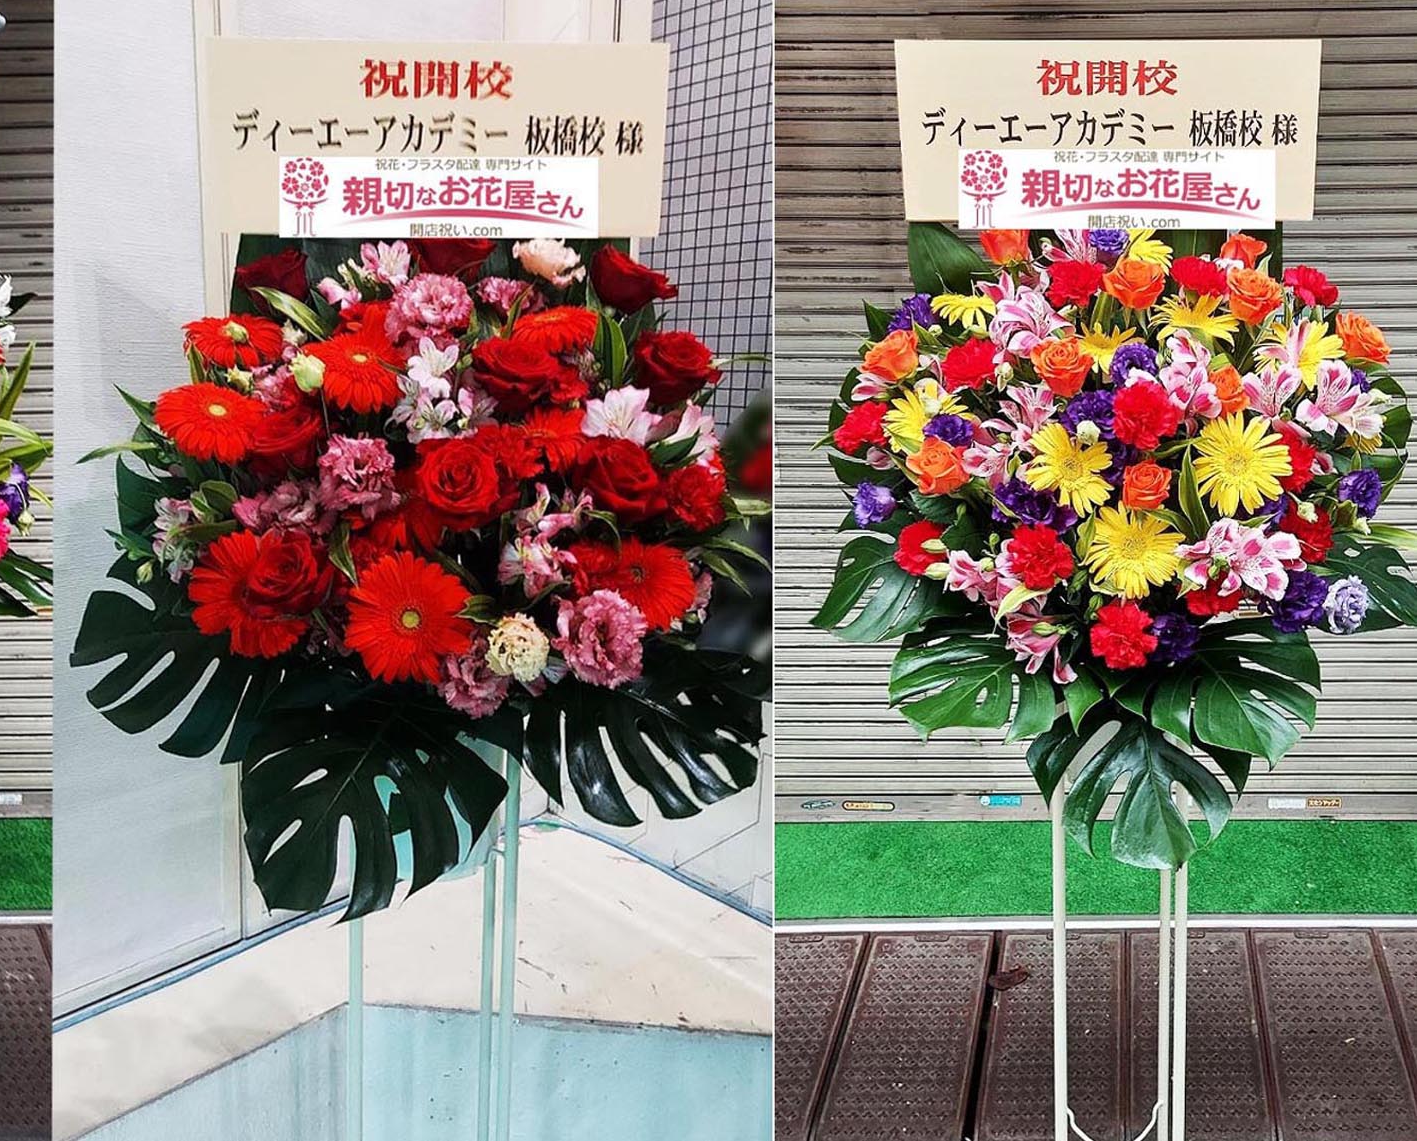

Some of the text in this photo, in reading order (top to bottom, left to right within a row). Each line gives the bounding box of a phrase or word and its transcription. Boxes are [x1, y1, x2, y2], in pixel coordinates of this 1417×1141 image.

[359, 60, 513, 100] 祝開校
[1037, 60, 1178, 96] 祝開校
[234, 110, 642, 155] ディーエーアカデミー 板橋校 様
[923, 107, 1297, 147] ディーエーアカデミー 板橋校 様
